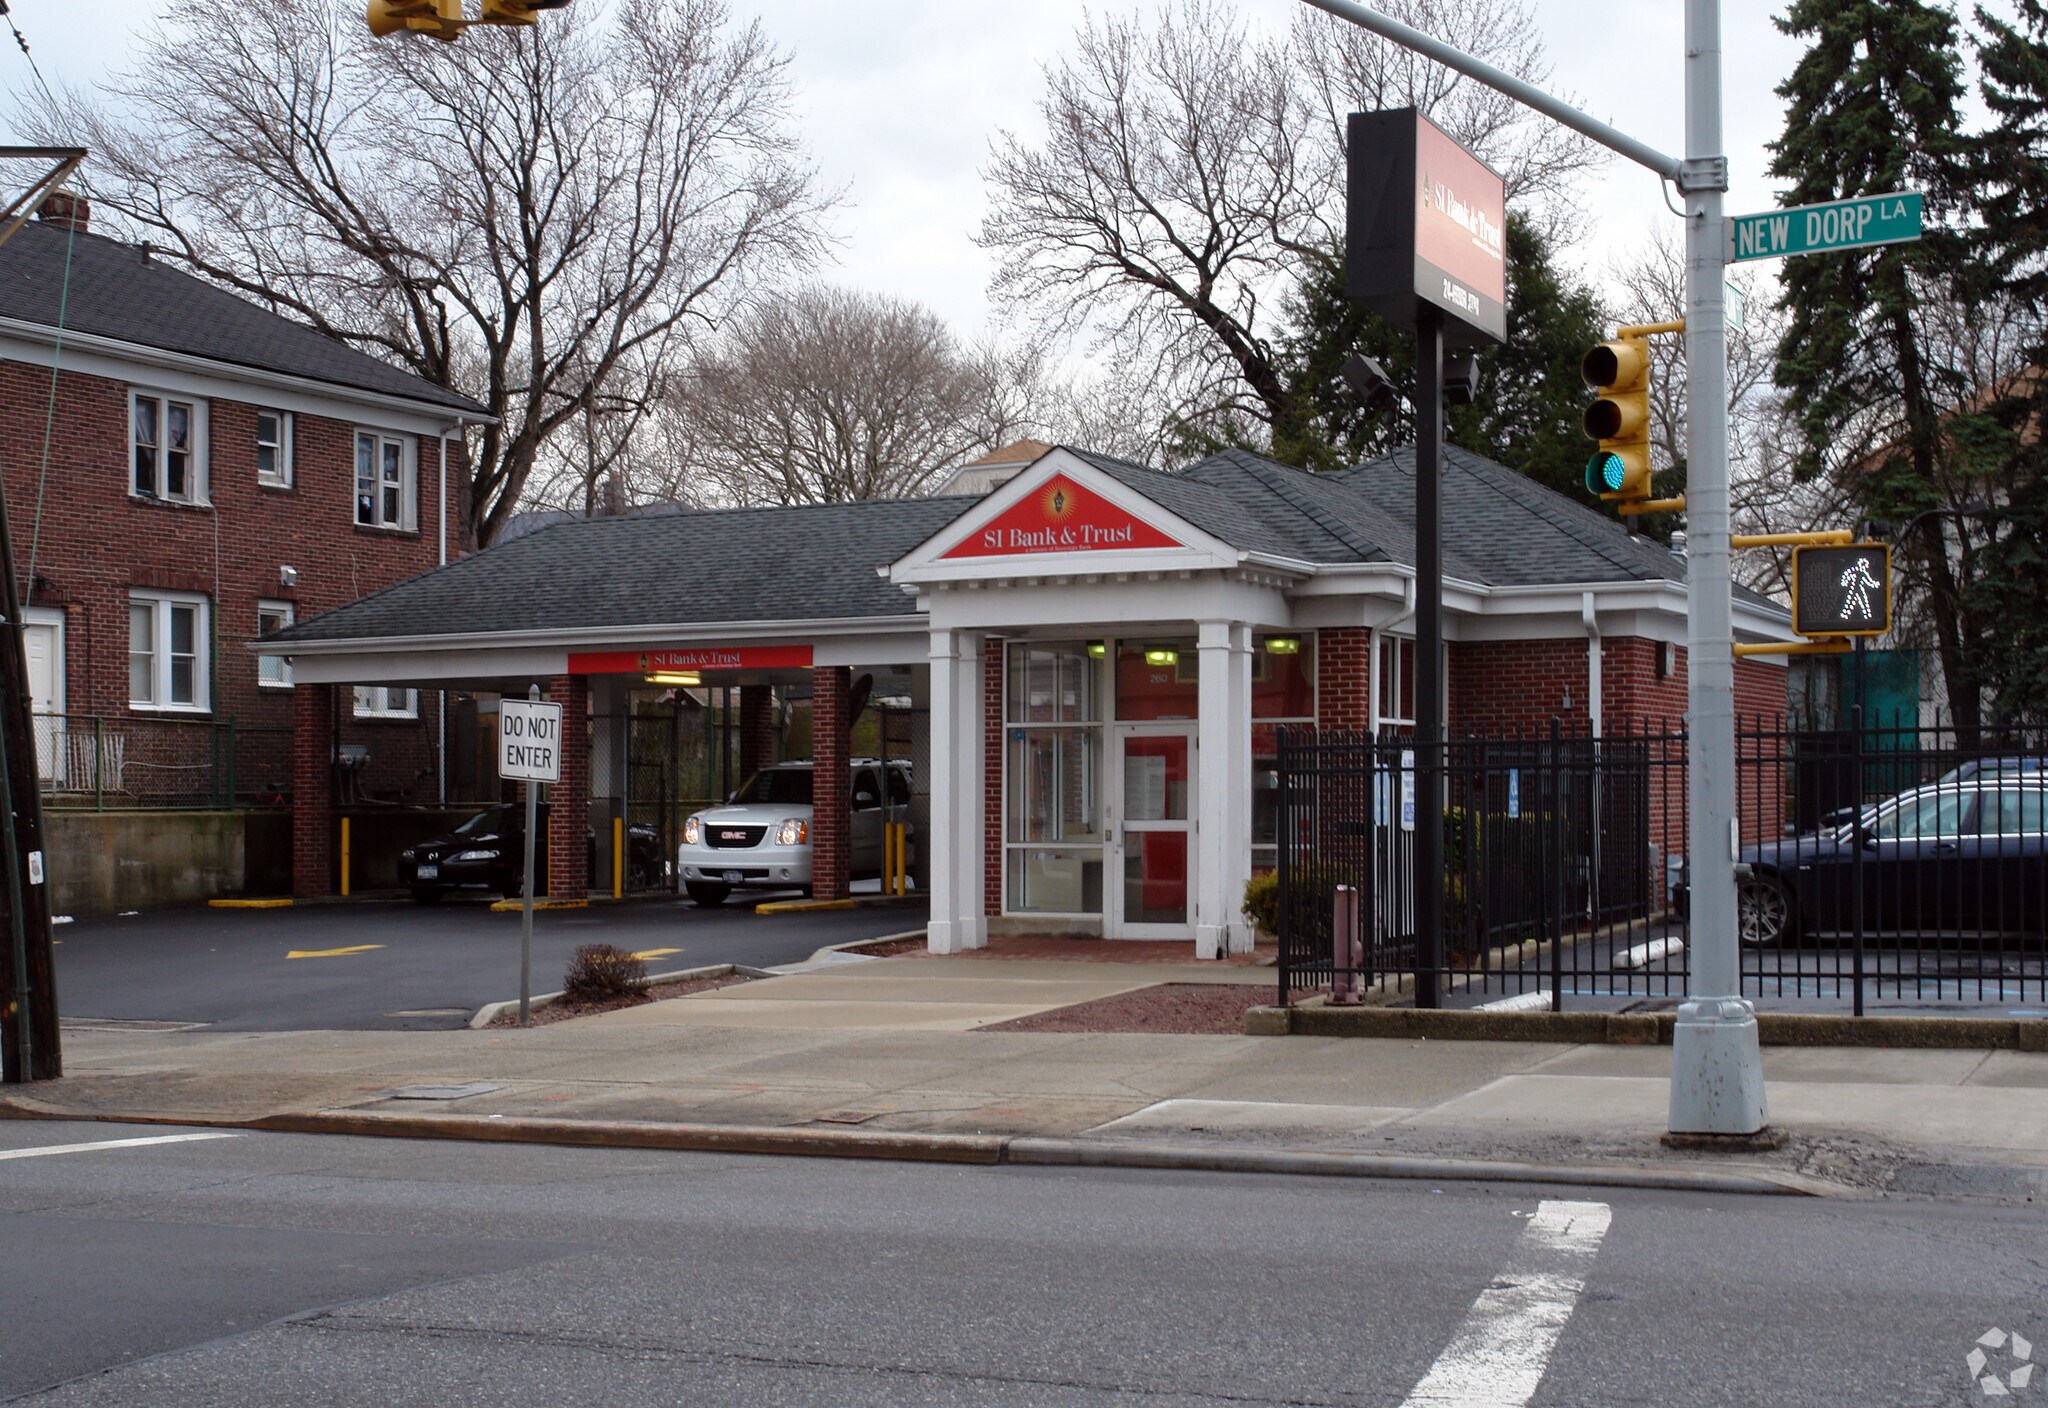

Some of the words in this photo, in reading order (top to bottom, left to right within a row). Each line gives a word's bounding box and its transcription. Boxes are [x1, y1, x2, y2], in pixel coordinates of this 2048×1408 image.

[1434, 180, 1446, 214] SI
[1446, 188, 1470, 231] Bank
[1469, 205, 1479, 236] &
[1478, 209, 1502, 252] Trust
[1739, 216, 1790, 256] NEW
[1806, 205, 1873, 247] DORP
[1881, 200, 1907, 220] LA
[984, 529, 1003, 549] SI
[1010, 527, 1057, 548] Bank
[1060, 525, 1077, 545] &
[1080, 523, 1133, 542] Trust
[654, 654, 666, 665] SI
[669, 653, 697, 665] Bank
[699, 653, 709, 664] &
[711, 651, 741, 664] Trust
[504, 715, 523, 737] DO
[528, 717, 556, 740] NOT
[507, 744, 552, 769] ENTER
[721, 831, 746, 840] GMC
